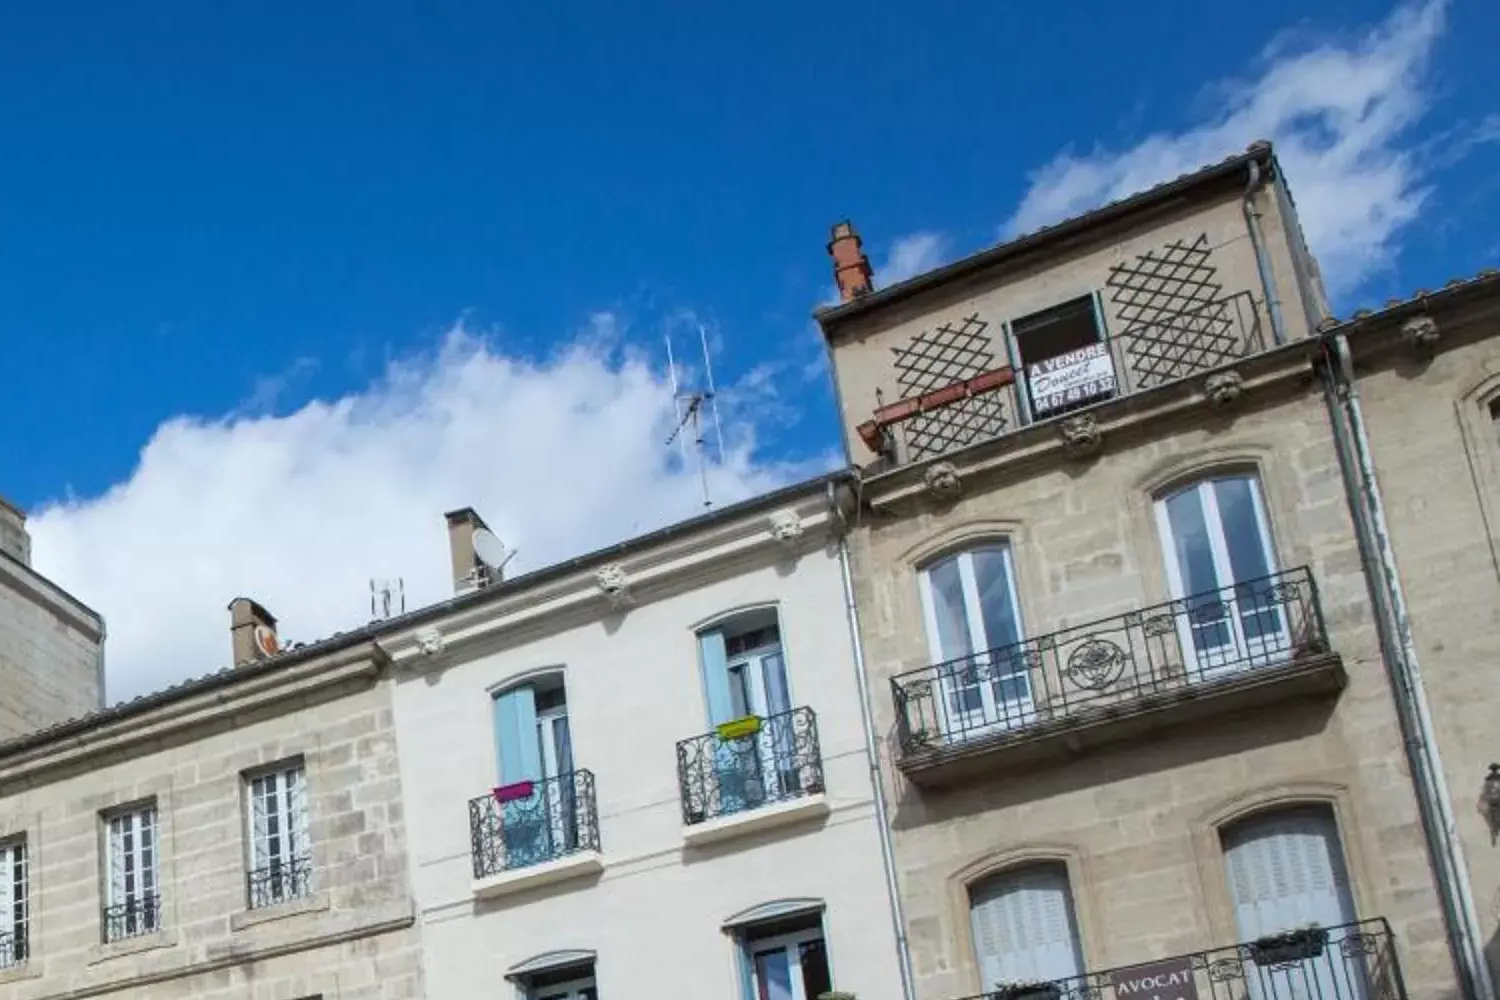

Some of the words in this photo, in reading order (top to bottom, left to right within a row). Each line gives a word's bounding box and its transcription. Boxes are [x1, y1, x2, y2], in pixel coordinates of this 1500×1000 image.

[1030, 364, 1042, 378] A
[1044, 343, 1107, 371] VENDRE
[1118, 970, 1190, 995] AVOCAT
